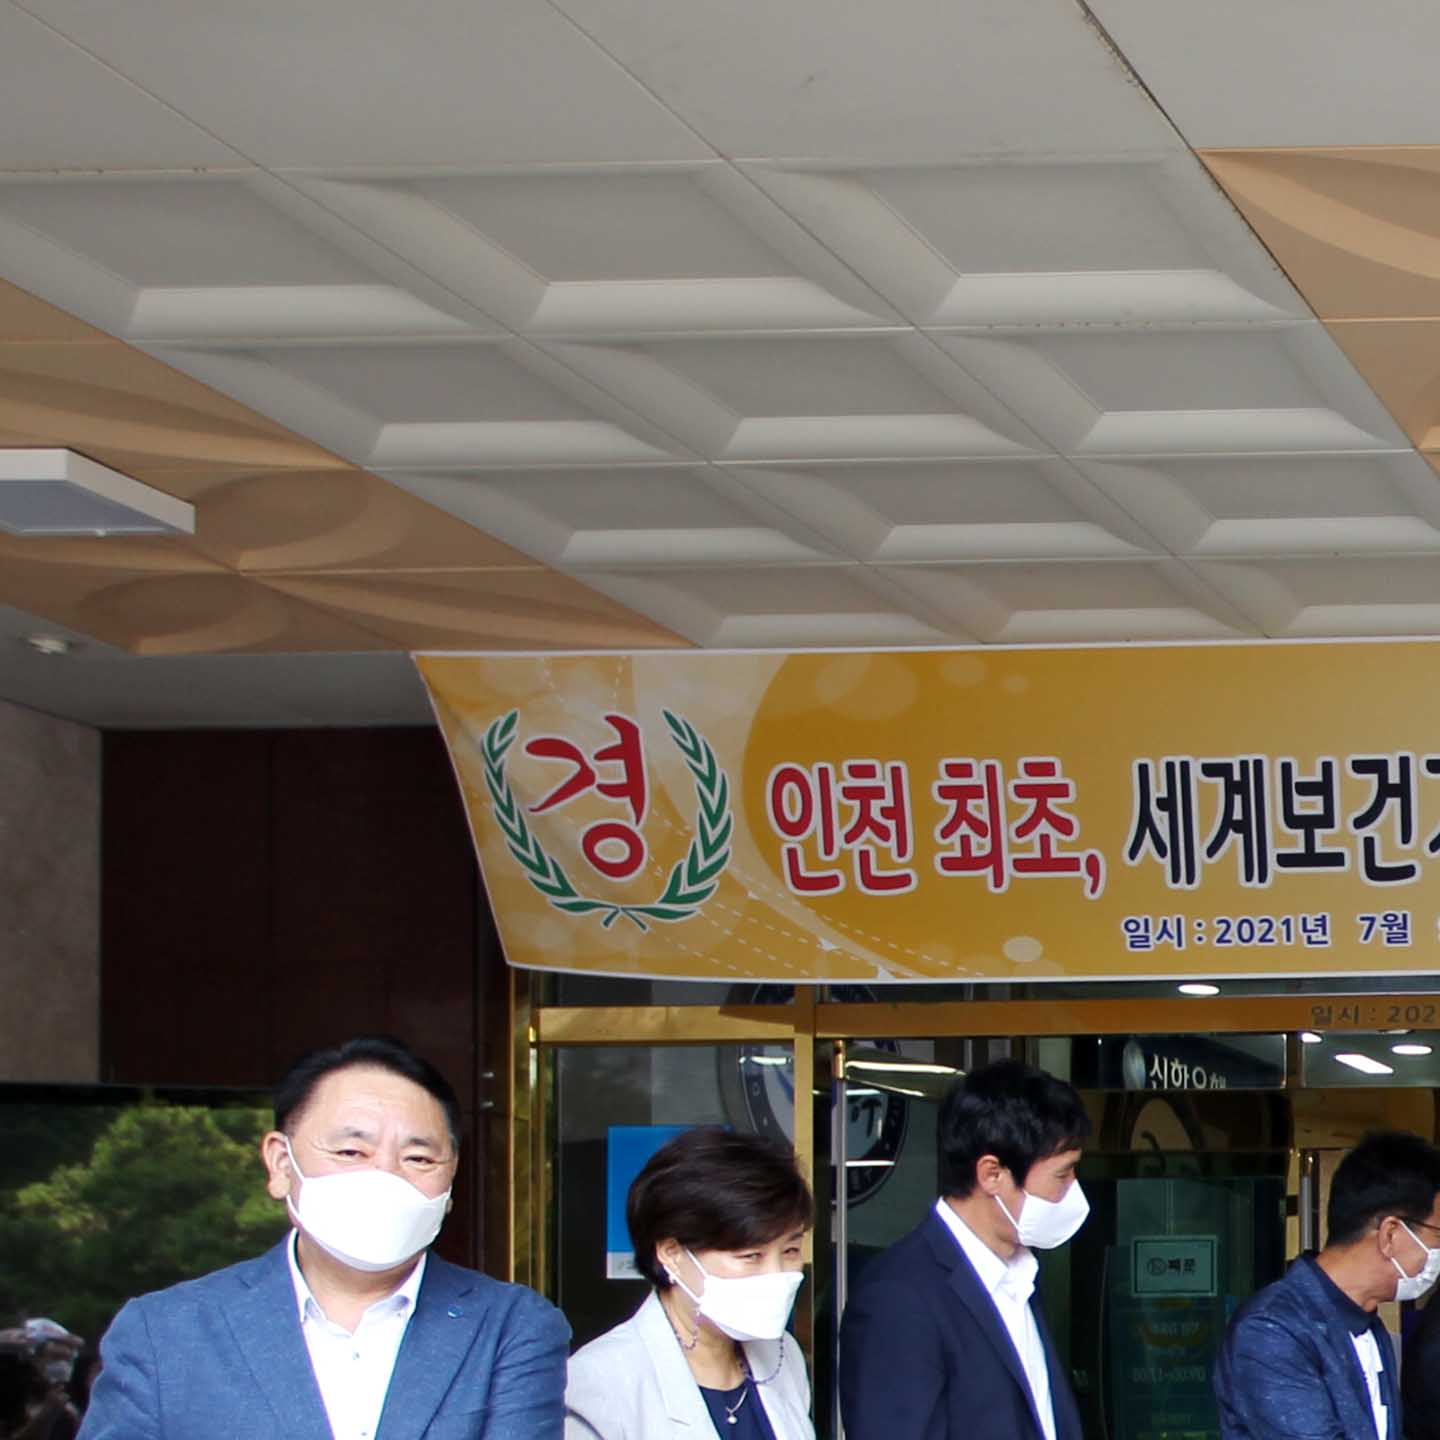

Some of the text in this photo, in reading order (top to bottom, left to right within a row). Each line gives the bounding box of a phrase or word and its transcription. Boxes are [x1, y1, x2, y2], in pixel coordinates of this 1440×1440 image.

[525, 715, 648, 878] 경
[769, 761, 913, 891] 인천
[935, 758, 1103, 895] 최초,
[1215, 916, 1330, 946] 2021년
[1359, 913, 1411, 944] 7월
